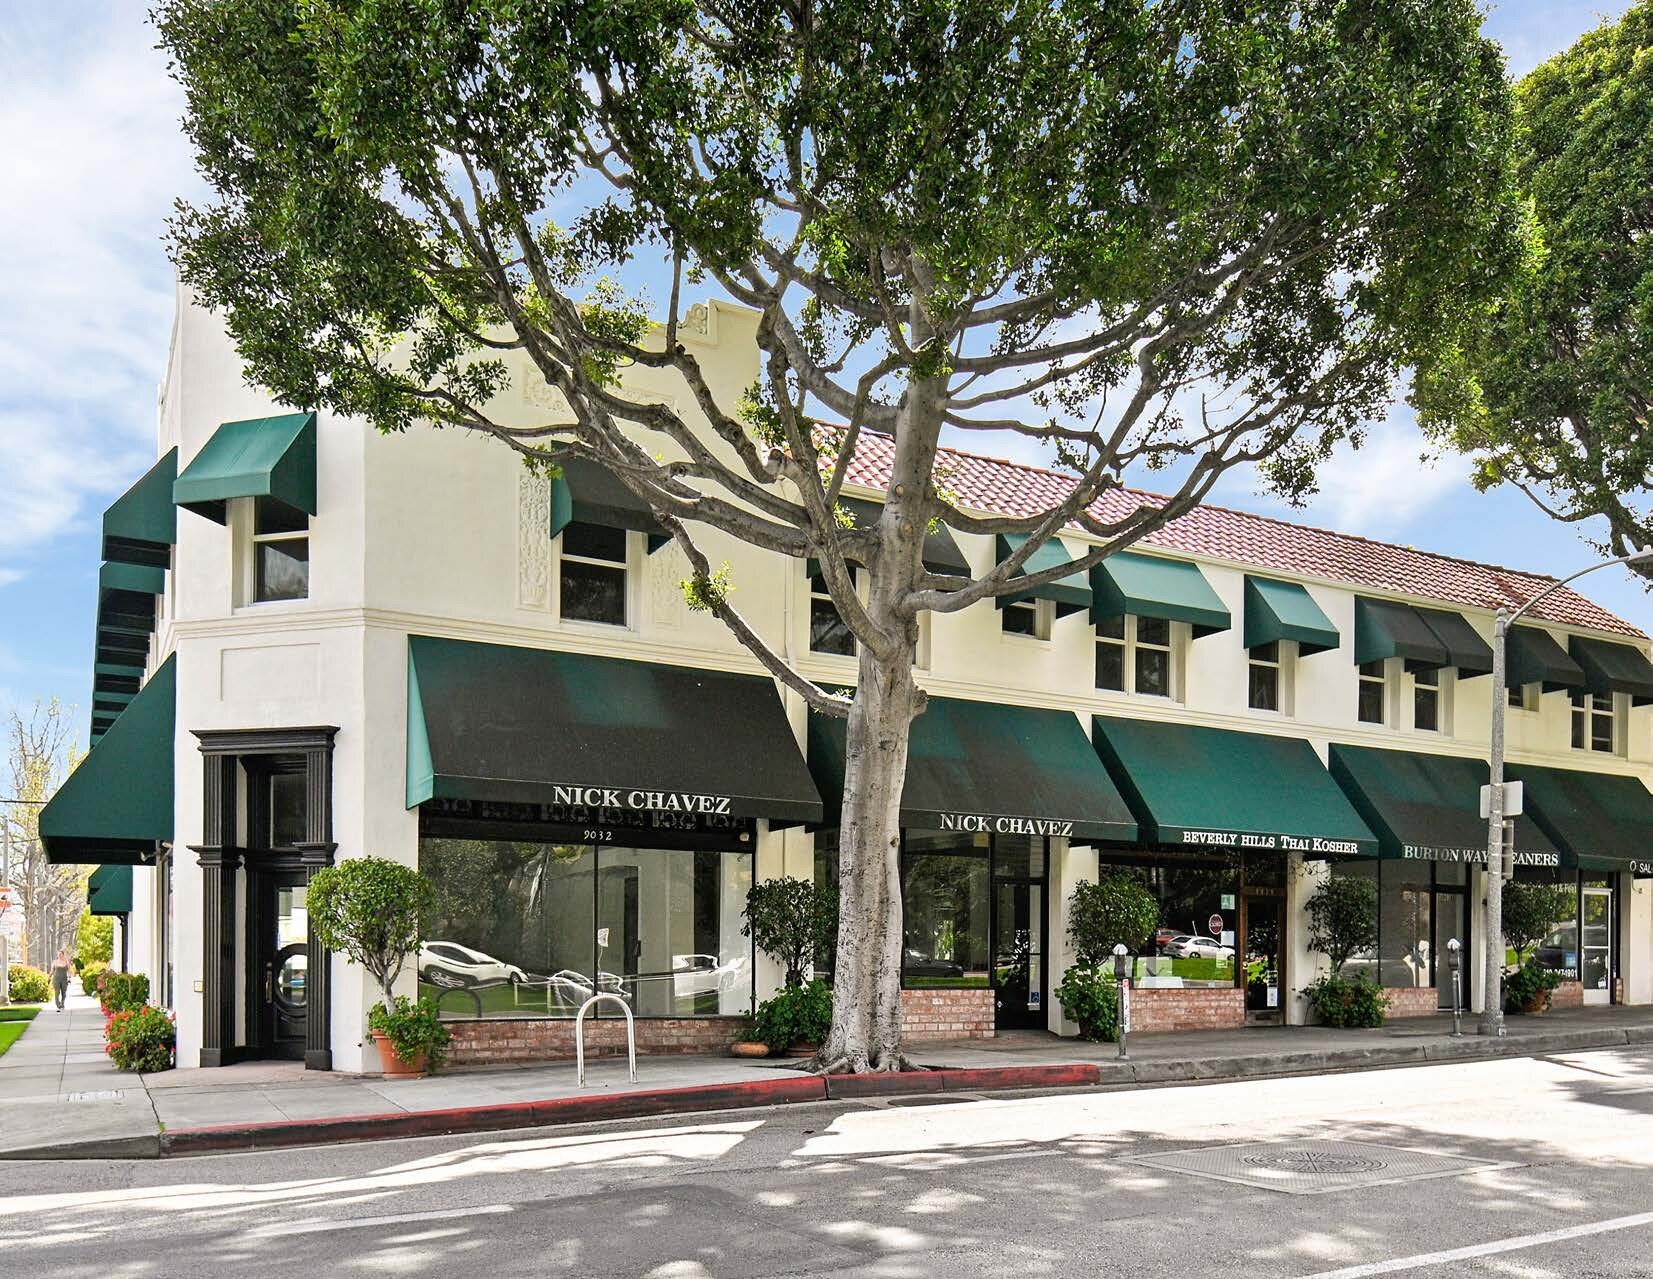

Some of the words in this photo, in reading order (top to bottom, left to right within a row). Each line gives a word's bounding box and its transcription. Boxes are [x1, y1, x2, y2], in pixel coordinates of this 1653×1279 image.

[552, 786, 622, 808] NICK
[628, 791, 731, 814] CHAVEZ
[583, 830, 612, 841] 9032
[940, 814, 992, 832] NICK
[996, 817, 1073, 836] CHAVEZ
[1183, 831, 1237, 845] BEVERLY
[1241, 835, 1275, 848] HILLS
[1404, 845, 1458, 861] BURTON
[1463, 850, 1489, 863] WAY
[1513, 852, 1559, 866] EANERS
